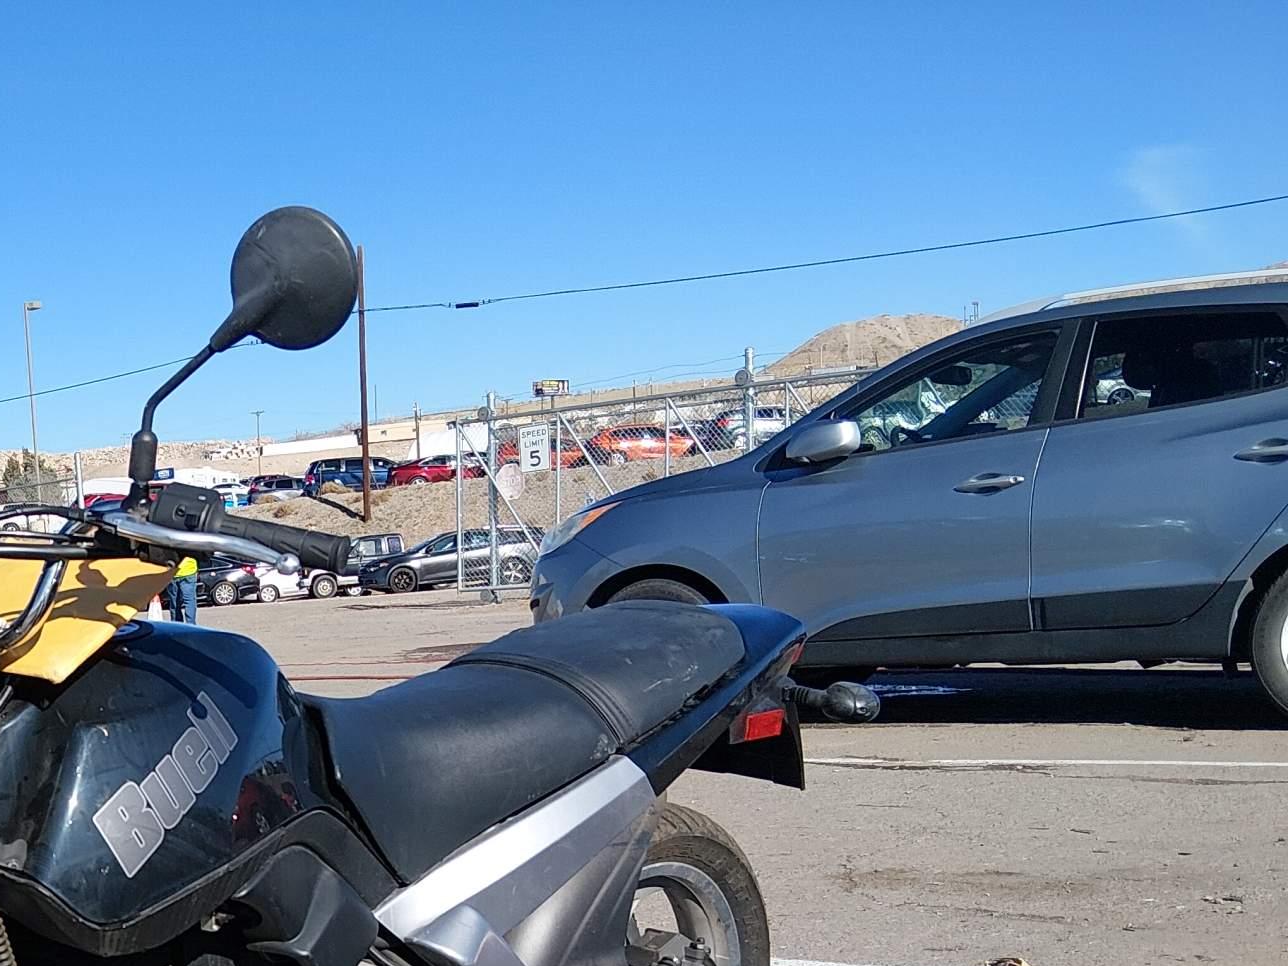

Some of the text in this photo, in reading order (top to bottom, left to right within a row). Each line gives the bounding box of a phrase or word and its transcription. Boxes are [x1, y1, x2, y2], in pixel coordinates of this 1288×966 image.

[521, 429, 547, 439] SPEED
[524, 438, 545, 449] LIMIT
[529, 450, 541, 467] 5
[92, 690, 239, 879] Buell
